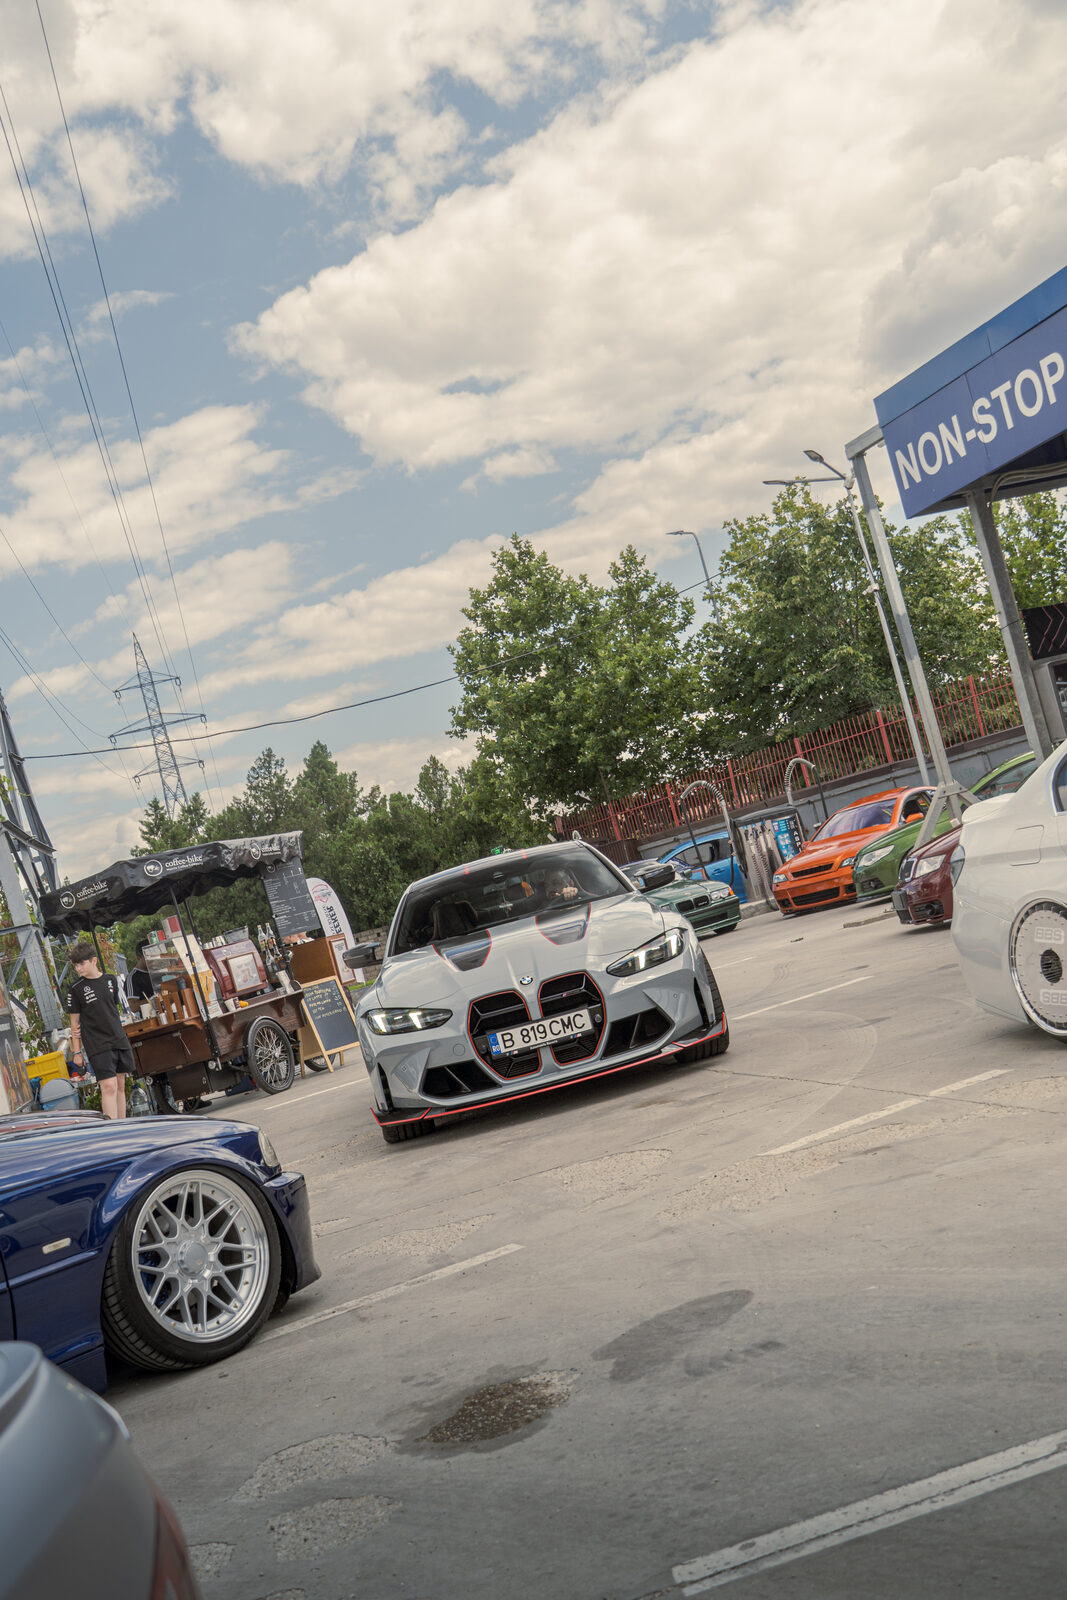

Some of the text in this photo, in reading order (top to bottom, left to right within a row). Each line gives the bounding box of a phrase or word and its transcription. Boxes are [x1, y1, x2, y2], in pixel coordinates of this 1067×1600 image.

[894, 352, 1065, 491] NON-STOP
[165, 854, 203, 868] coffee-bike
[501, 1013, 585, 1049] B 819 CMC
